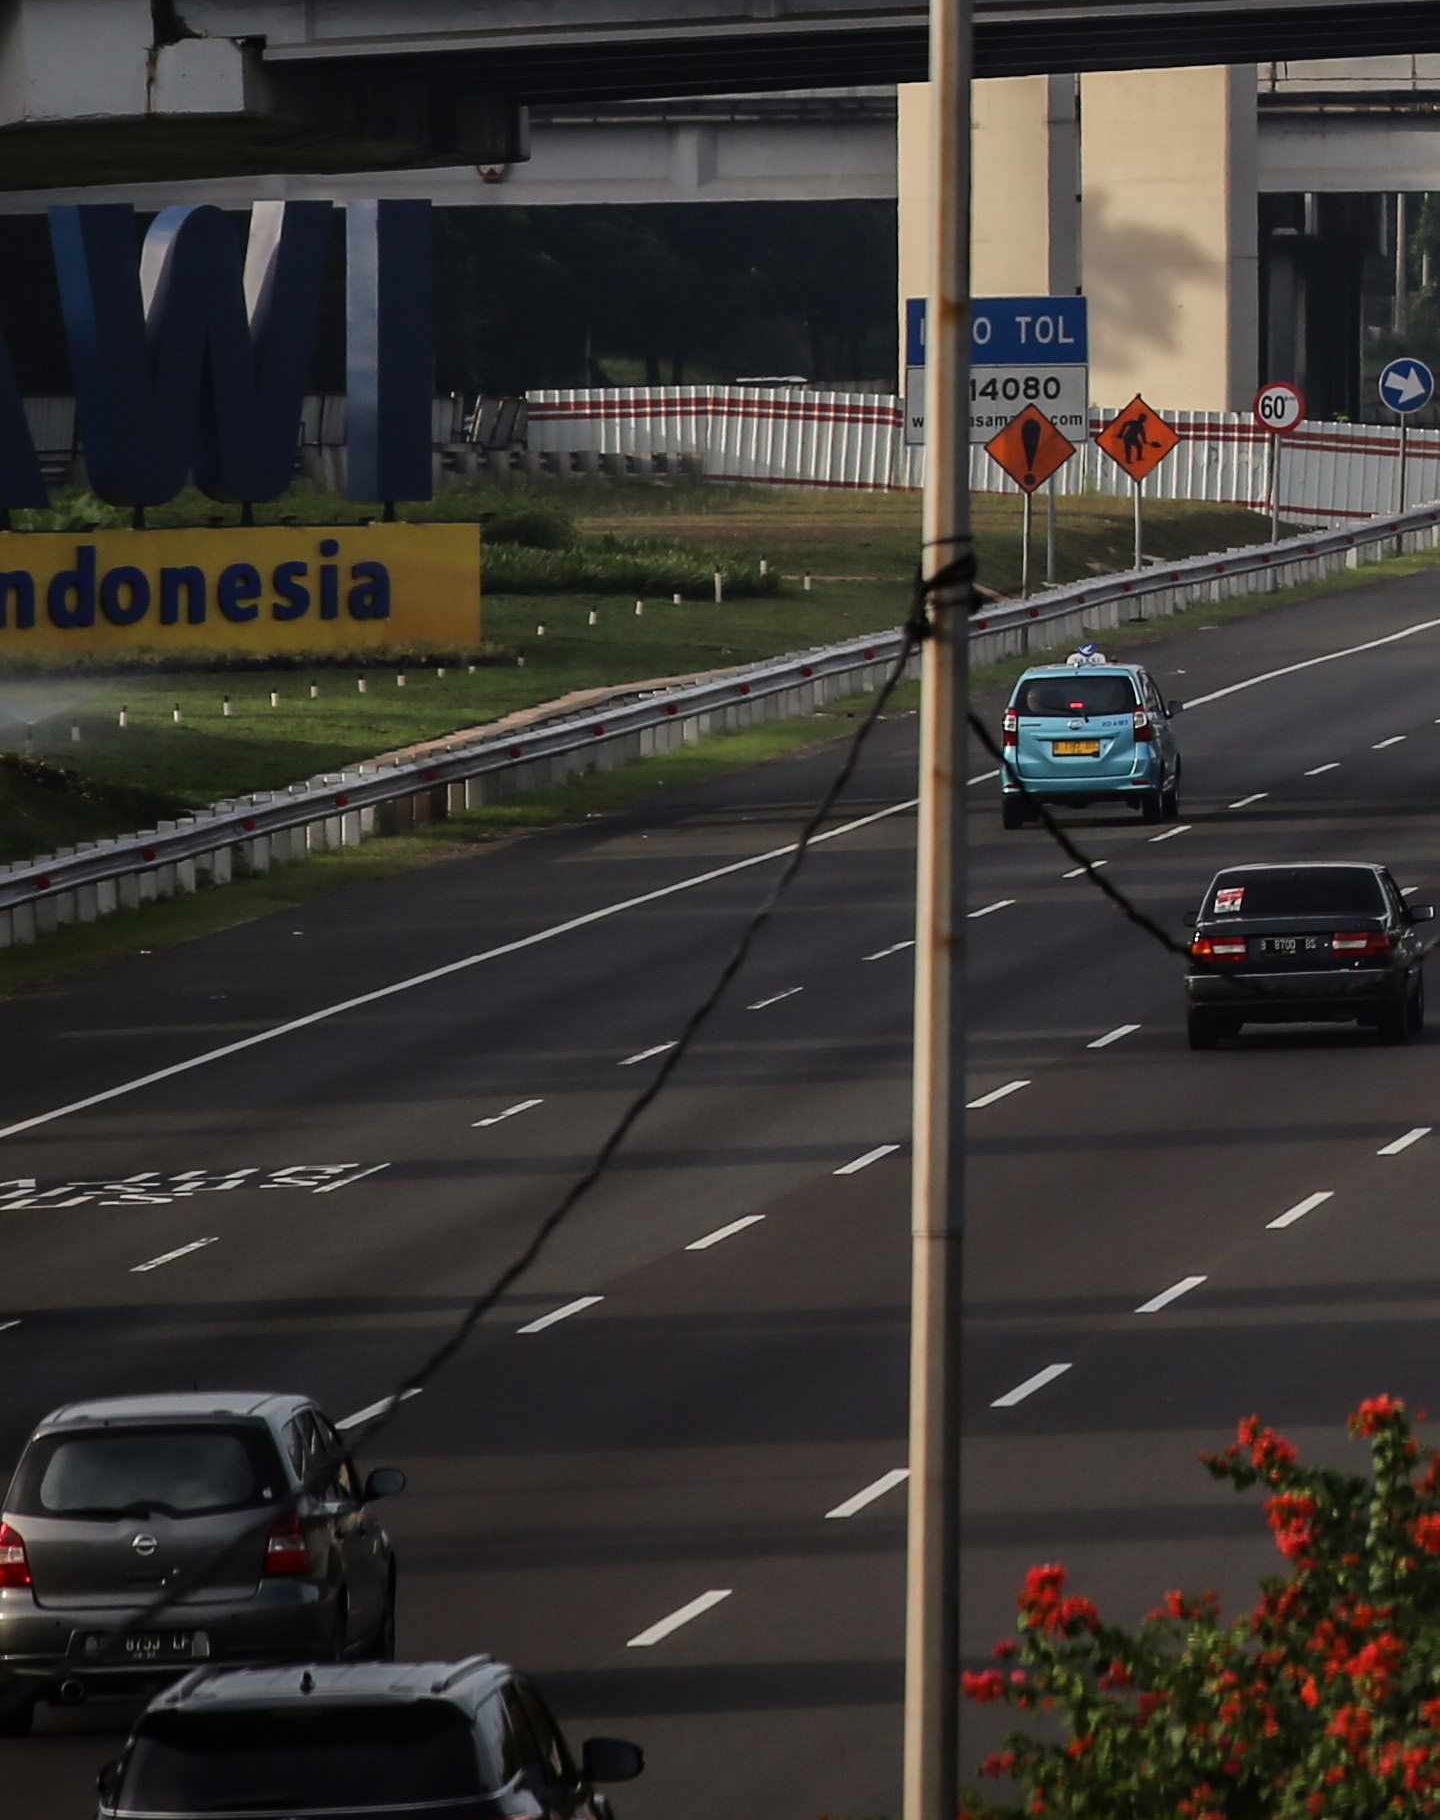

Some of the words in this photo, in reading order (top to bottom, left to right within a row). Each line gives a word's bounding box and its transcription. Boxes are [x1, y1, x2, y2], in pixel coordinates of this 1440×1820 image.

[920, 317, 992, 345] IO
[1015, 316, 1074, 345] TOL
[970, 377, 1061, 401] 14080
[1261, 395, 1285, 420] 60
